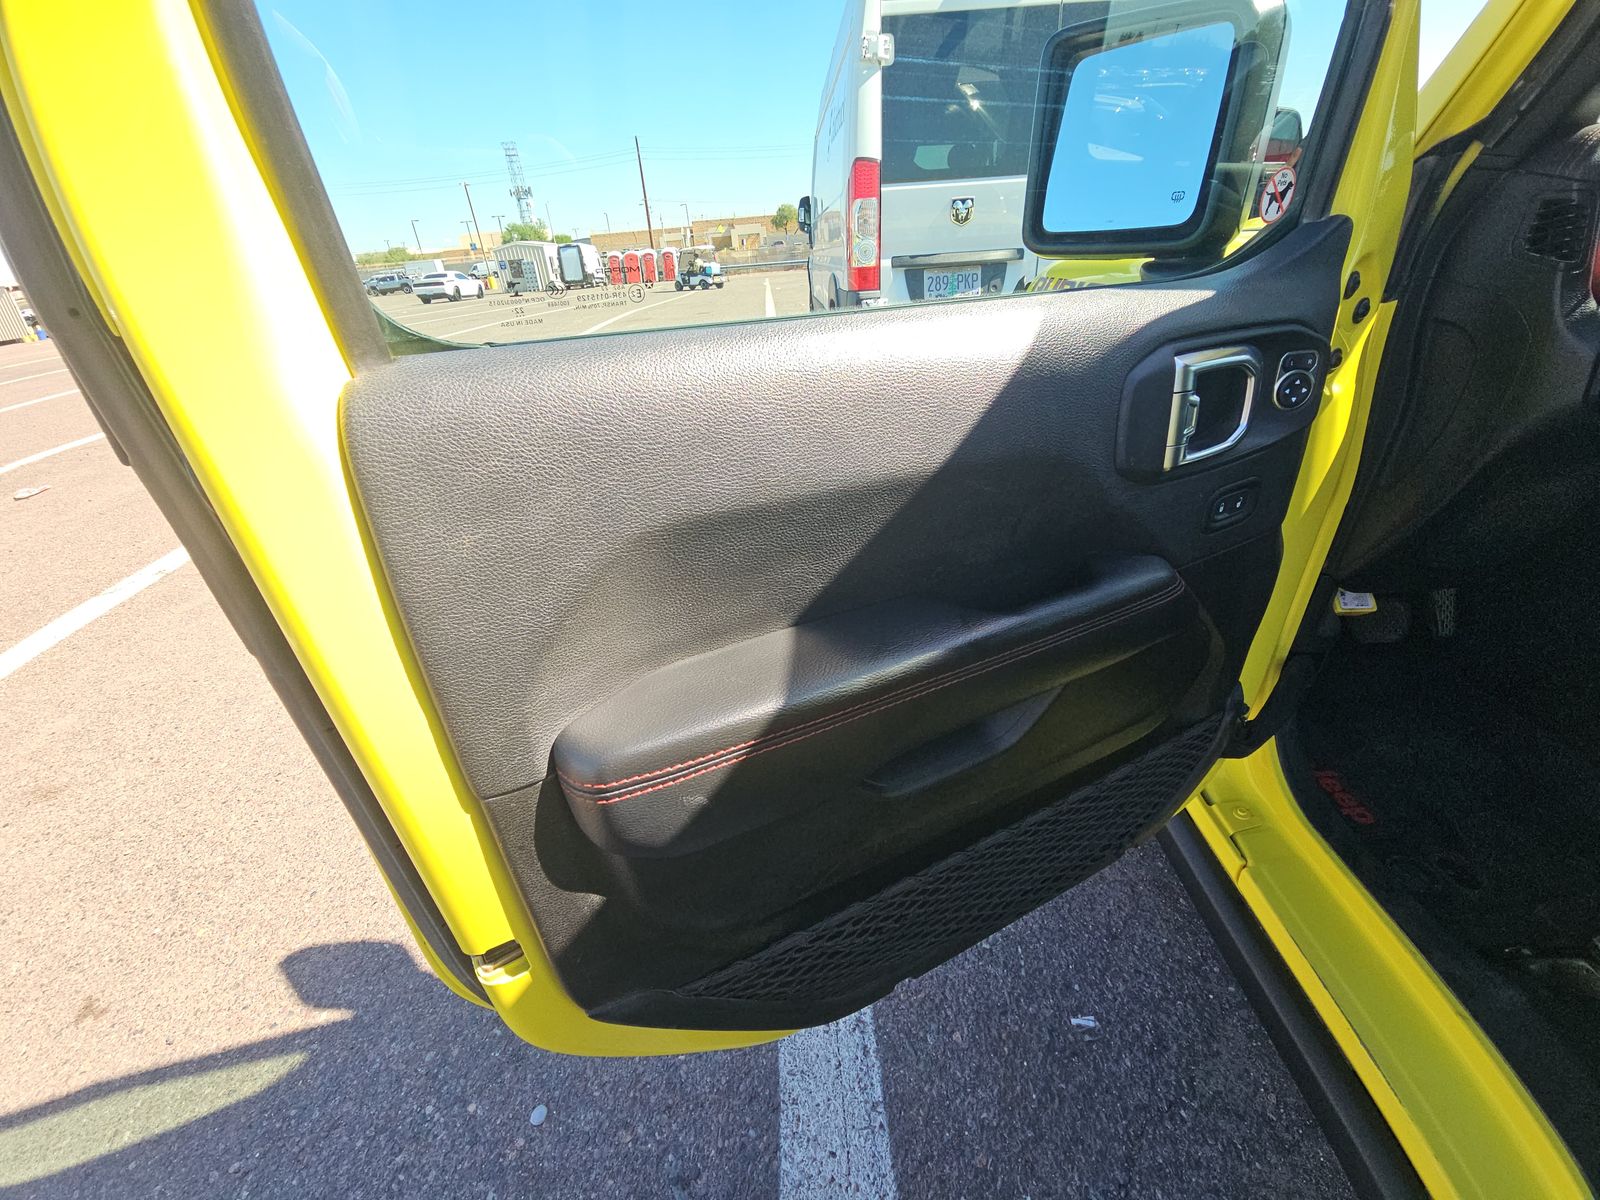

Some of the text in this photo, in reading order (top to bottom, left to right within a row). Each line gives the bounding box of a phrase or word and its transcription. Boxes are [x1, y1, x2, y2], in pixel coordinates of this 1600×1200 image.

[1277, 179, 1288, 187] Pets
[927, 272, 979, 292] 289 PKP
